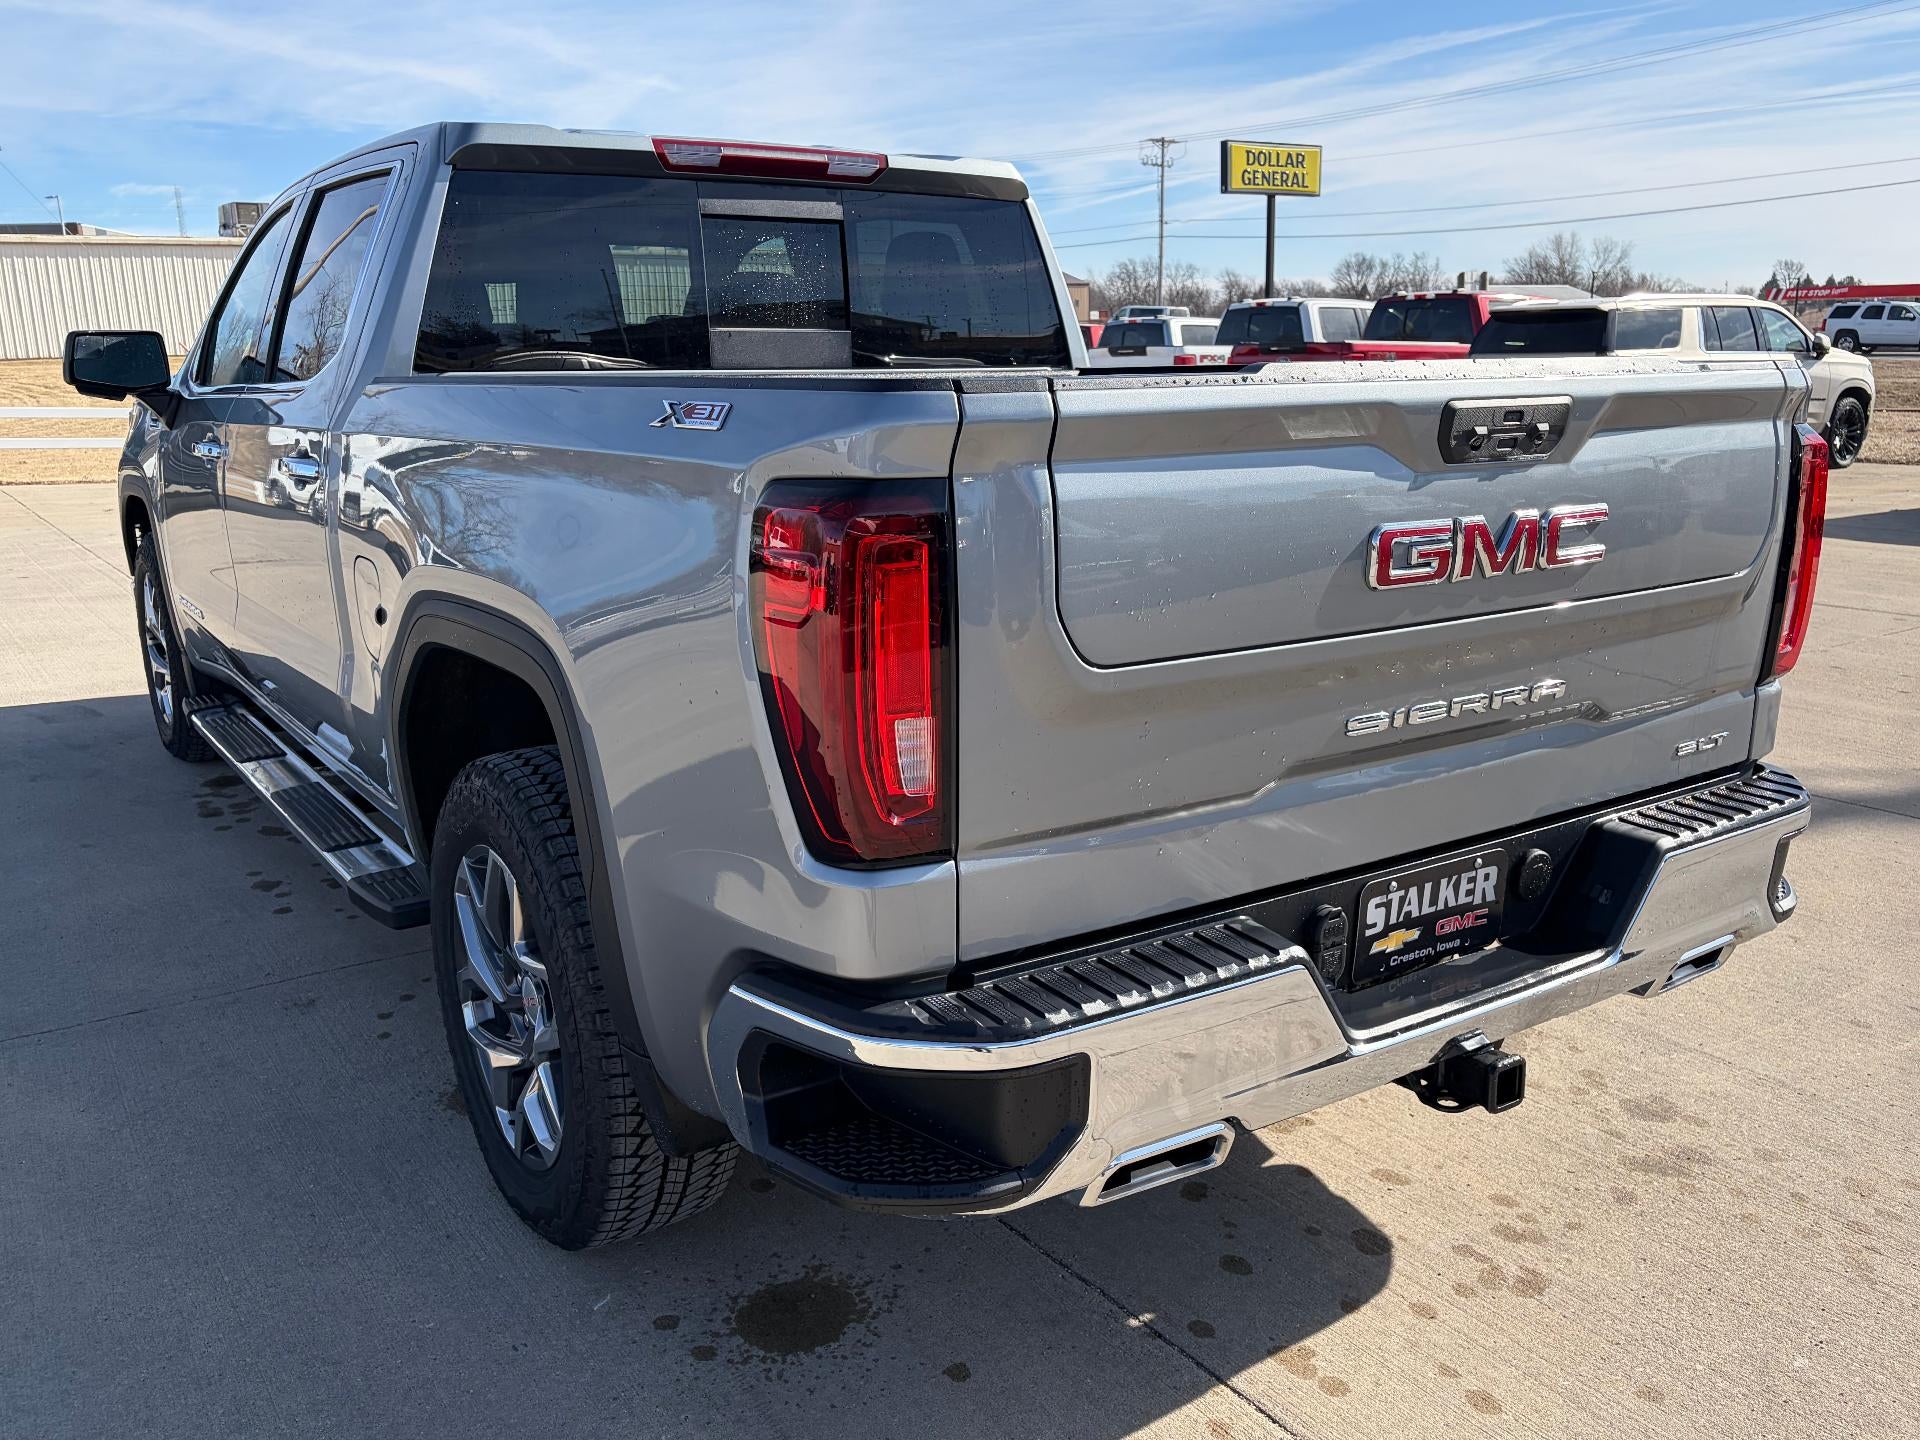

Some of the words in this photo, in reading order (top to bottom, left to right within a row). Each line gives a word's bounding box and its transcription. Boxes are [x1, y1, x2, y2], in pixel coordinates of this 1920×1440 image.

[1245, 149, 1306, 169] DOLLAR
[1241, 169, 1309, 188] GENERAL
[1808, 289, 1831, 297] STOP
[1199, 354, 1226, 363] FX4
[649, 399, 726, 430] X31
[1366, 503, 1608, 591] GMC
[1345, 679, 1567, 737] SIERRA
[1675, 731, 1730, 756] SLT
[1365, 865, 1498, 937] STALKER
[1435, 908, 1489, 936] GMC
[1389, 946, 1435, 967] Creston,
[1436, 937, 1461, 952] Iowa
